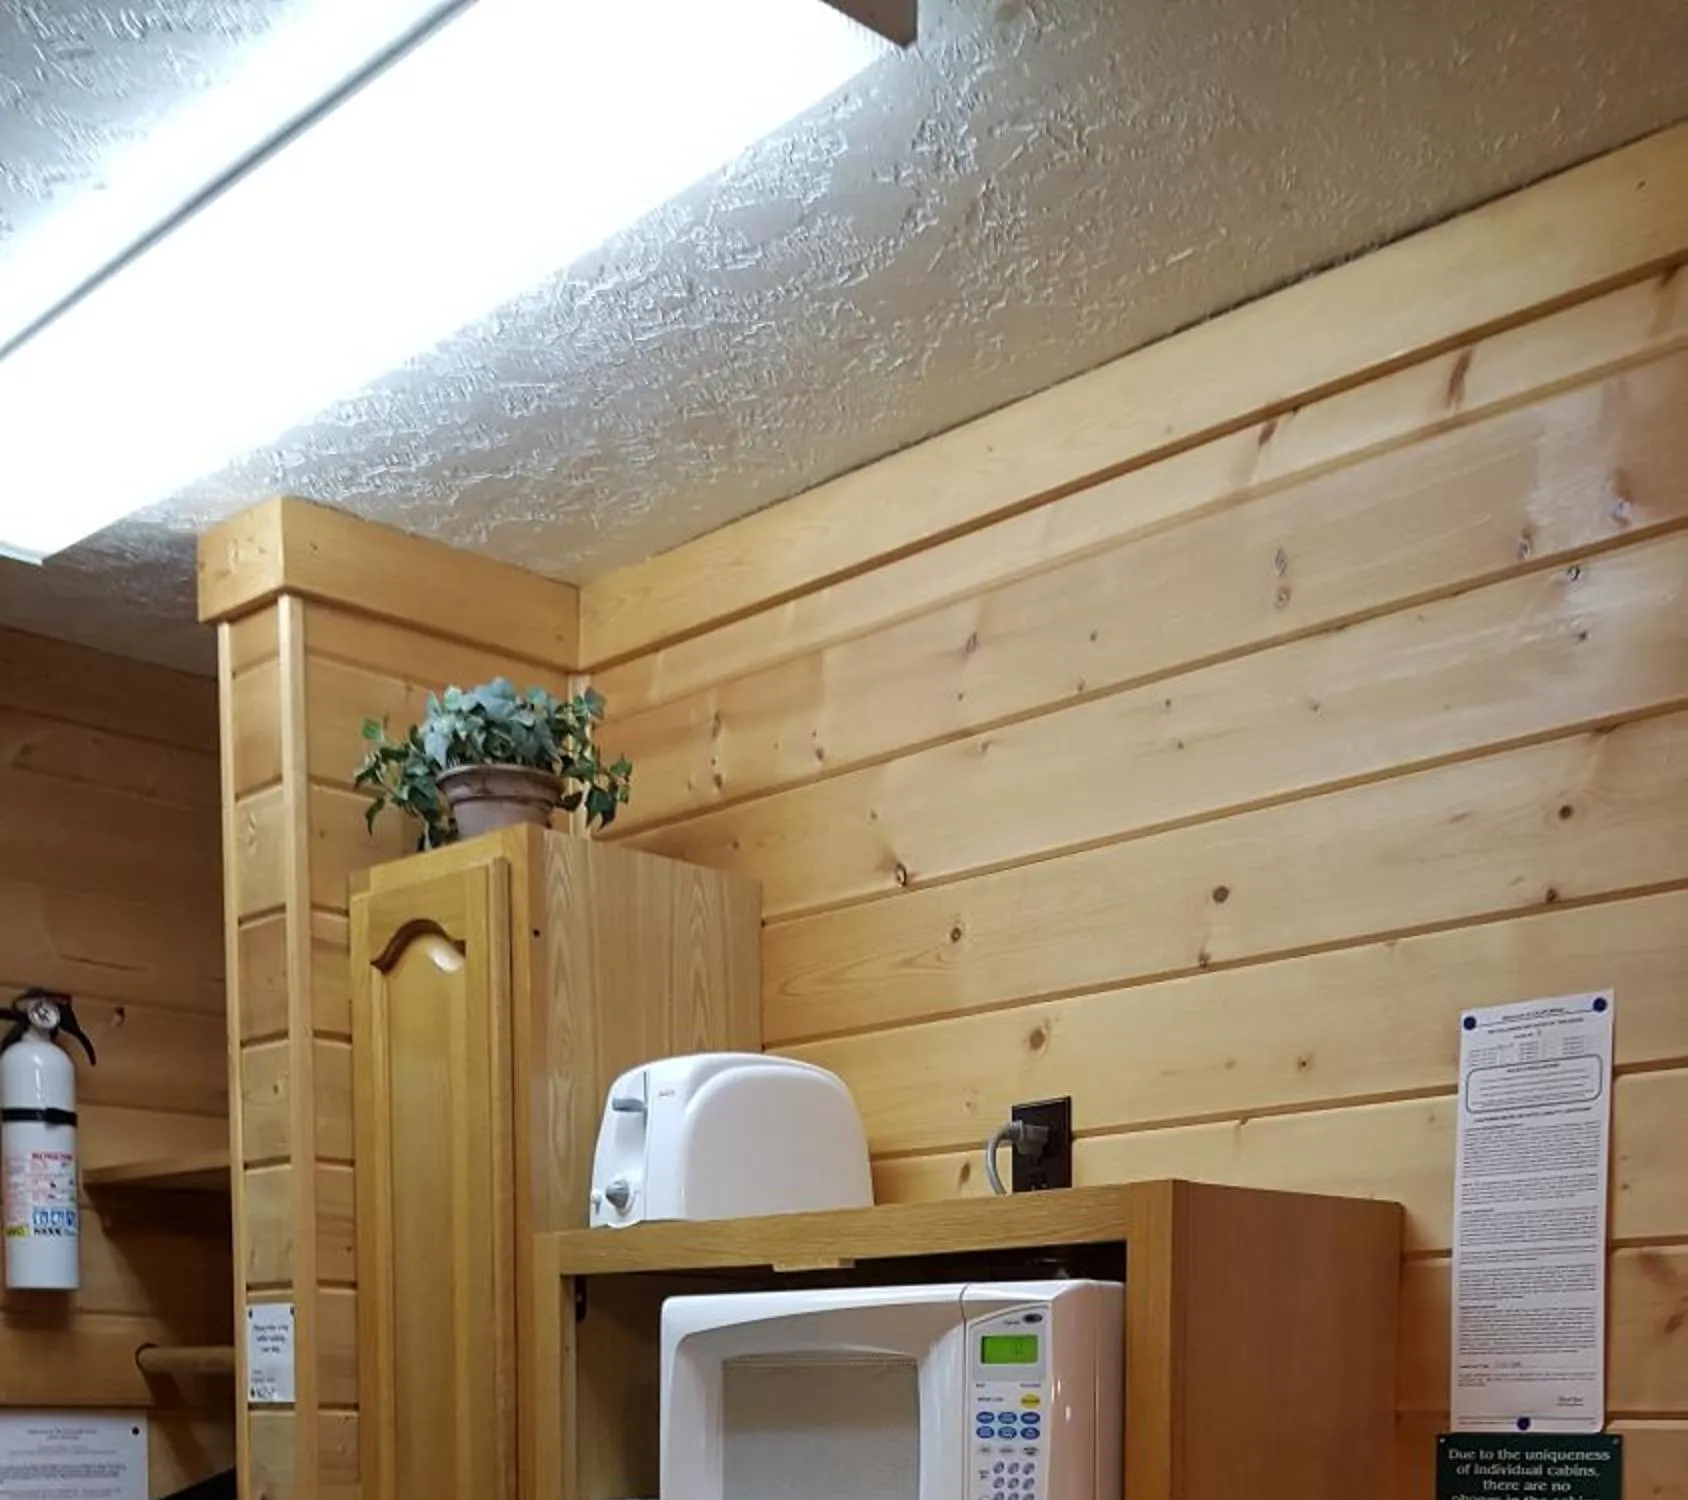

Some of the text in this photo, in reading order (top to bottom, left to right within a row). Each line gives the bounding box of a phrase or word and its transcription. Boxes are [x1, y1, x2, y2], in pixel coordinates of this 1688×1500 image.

[1448, 1448, 1611, 1463] Due to the uniqueness
[1456, 1463, 1471, 1475] of
[1474, 1463, 1543, 1476] individual
[1483, 1480, 1571, 1492] there are no
